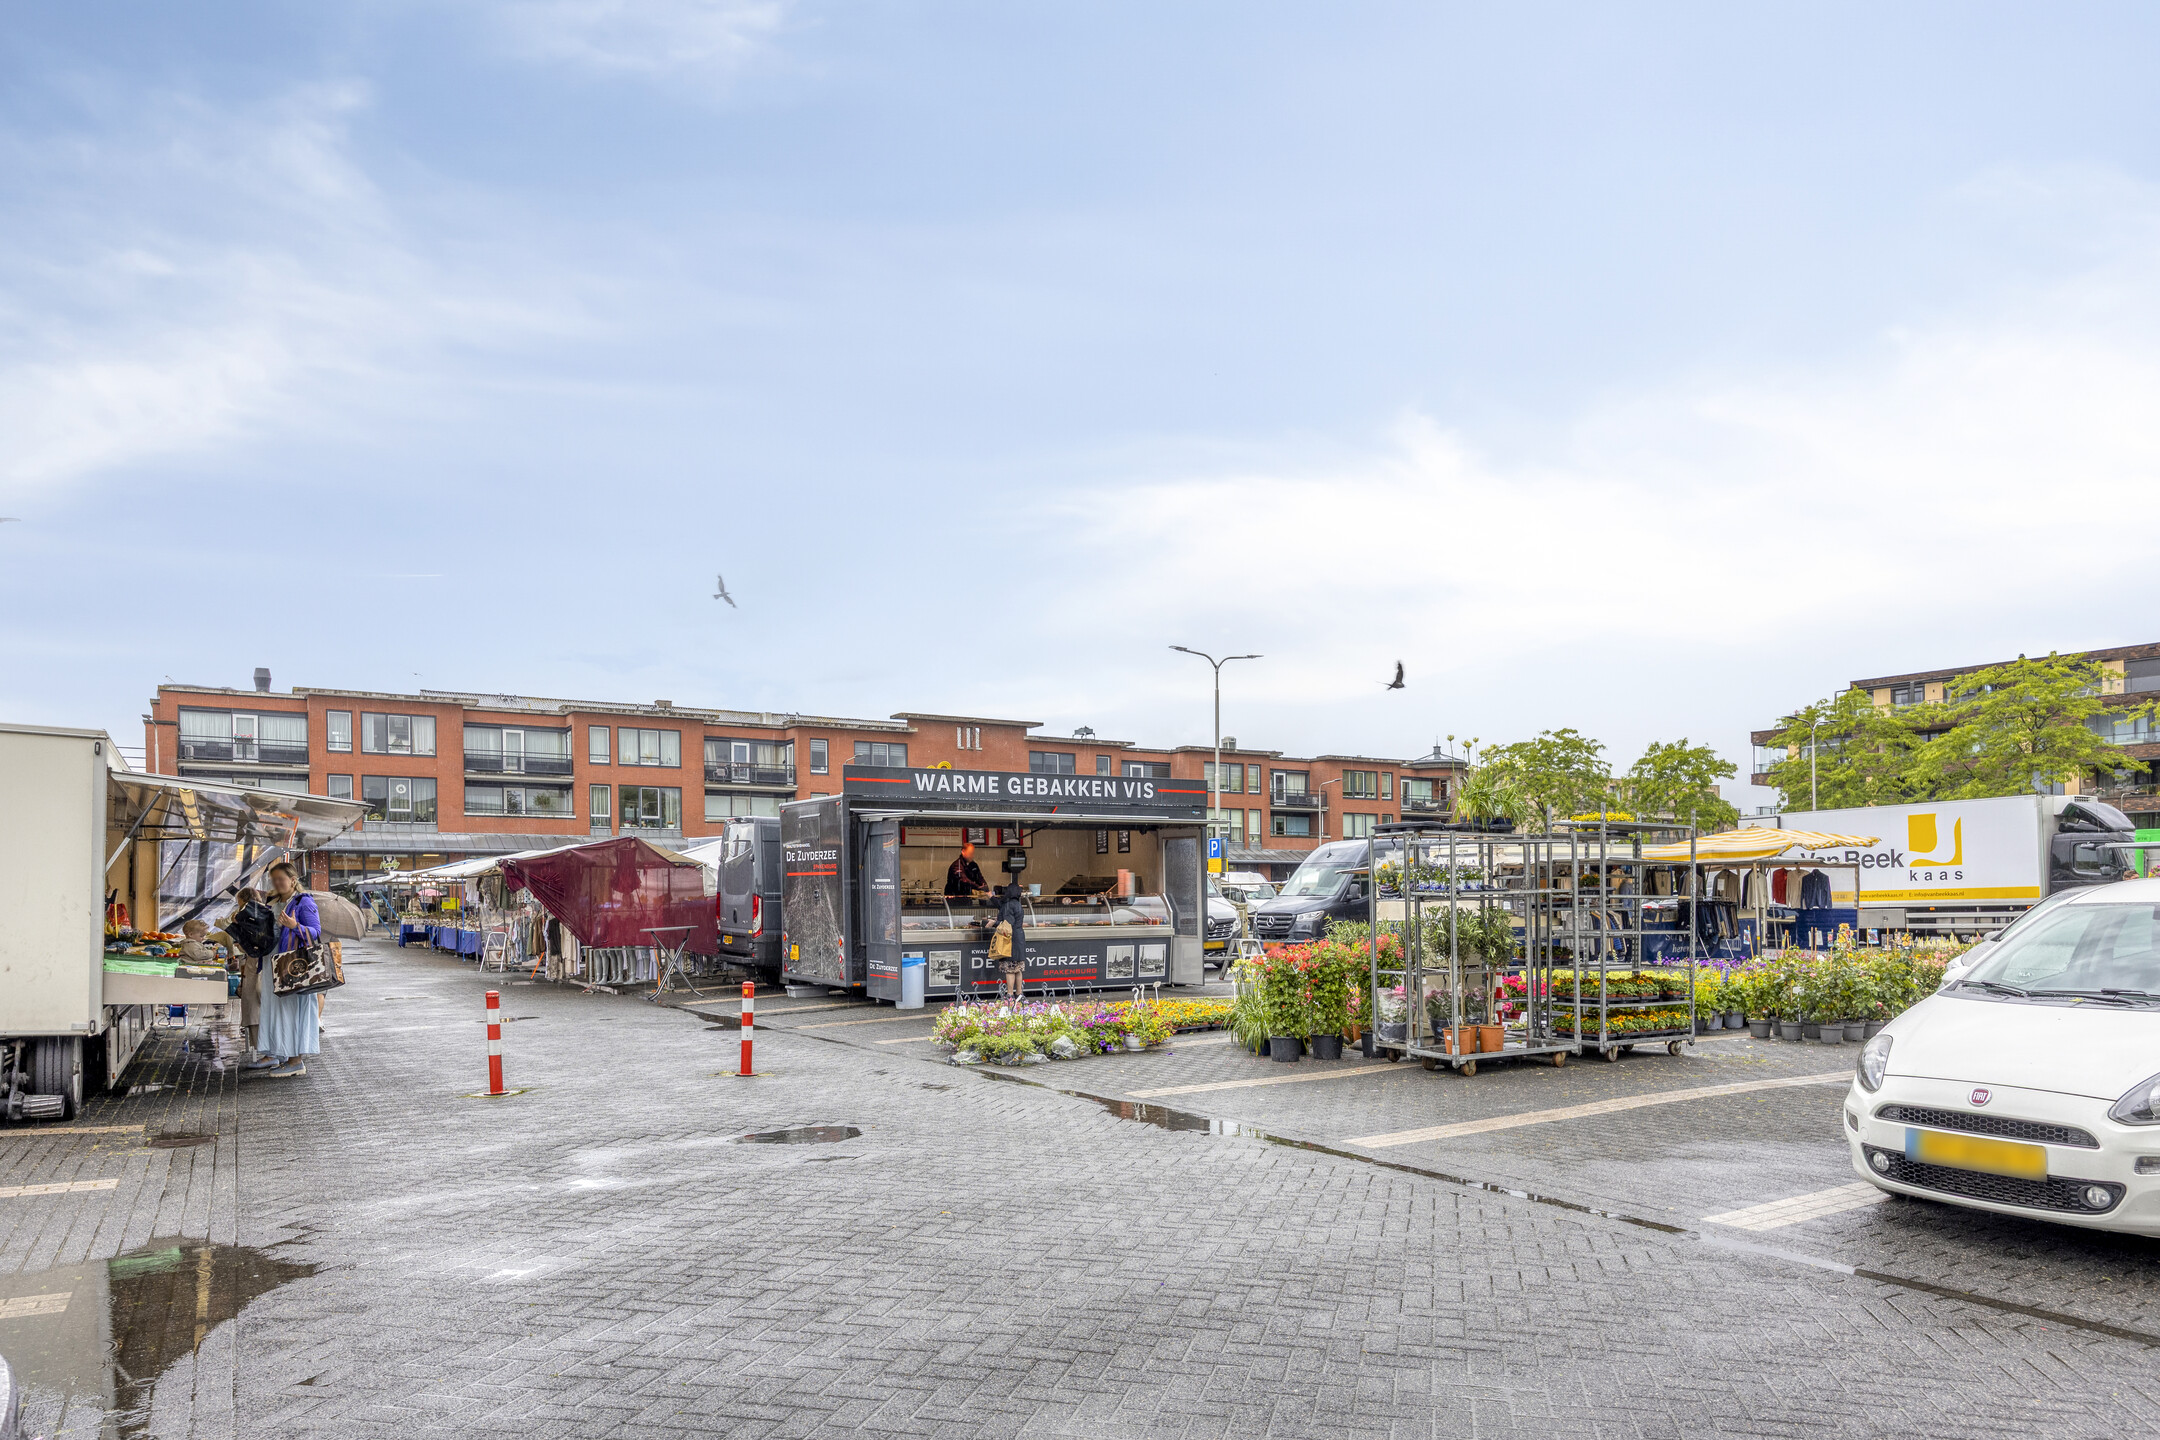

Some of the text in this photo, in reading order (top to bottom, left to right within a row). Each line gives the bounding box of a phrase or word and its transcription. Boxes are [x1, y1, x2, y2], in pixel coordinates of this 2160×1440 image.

[914, 773, 1154, 799] WARME GEBAKKEN VIS
[1211, 840, 1218, 857] P
[797, 850, 837, 861] ZUYDERZEE
[1845, 849, 1905, 869] Beek
[1909, 870, 1963, 882] kaas
[1043, 967, 1098, 976] SPAKENBURG
[1972, 1091, 1988, 1102] FIAT
